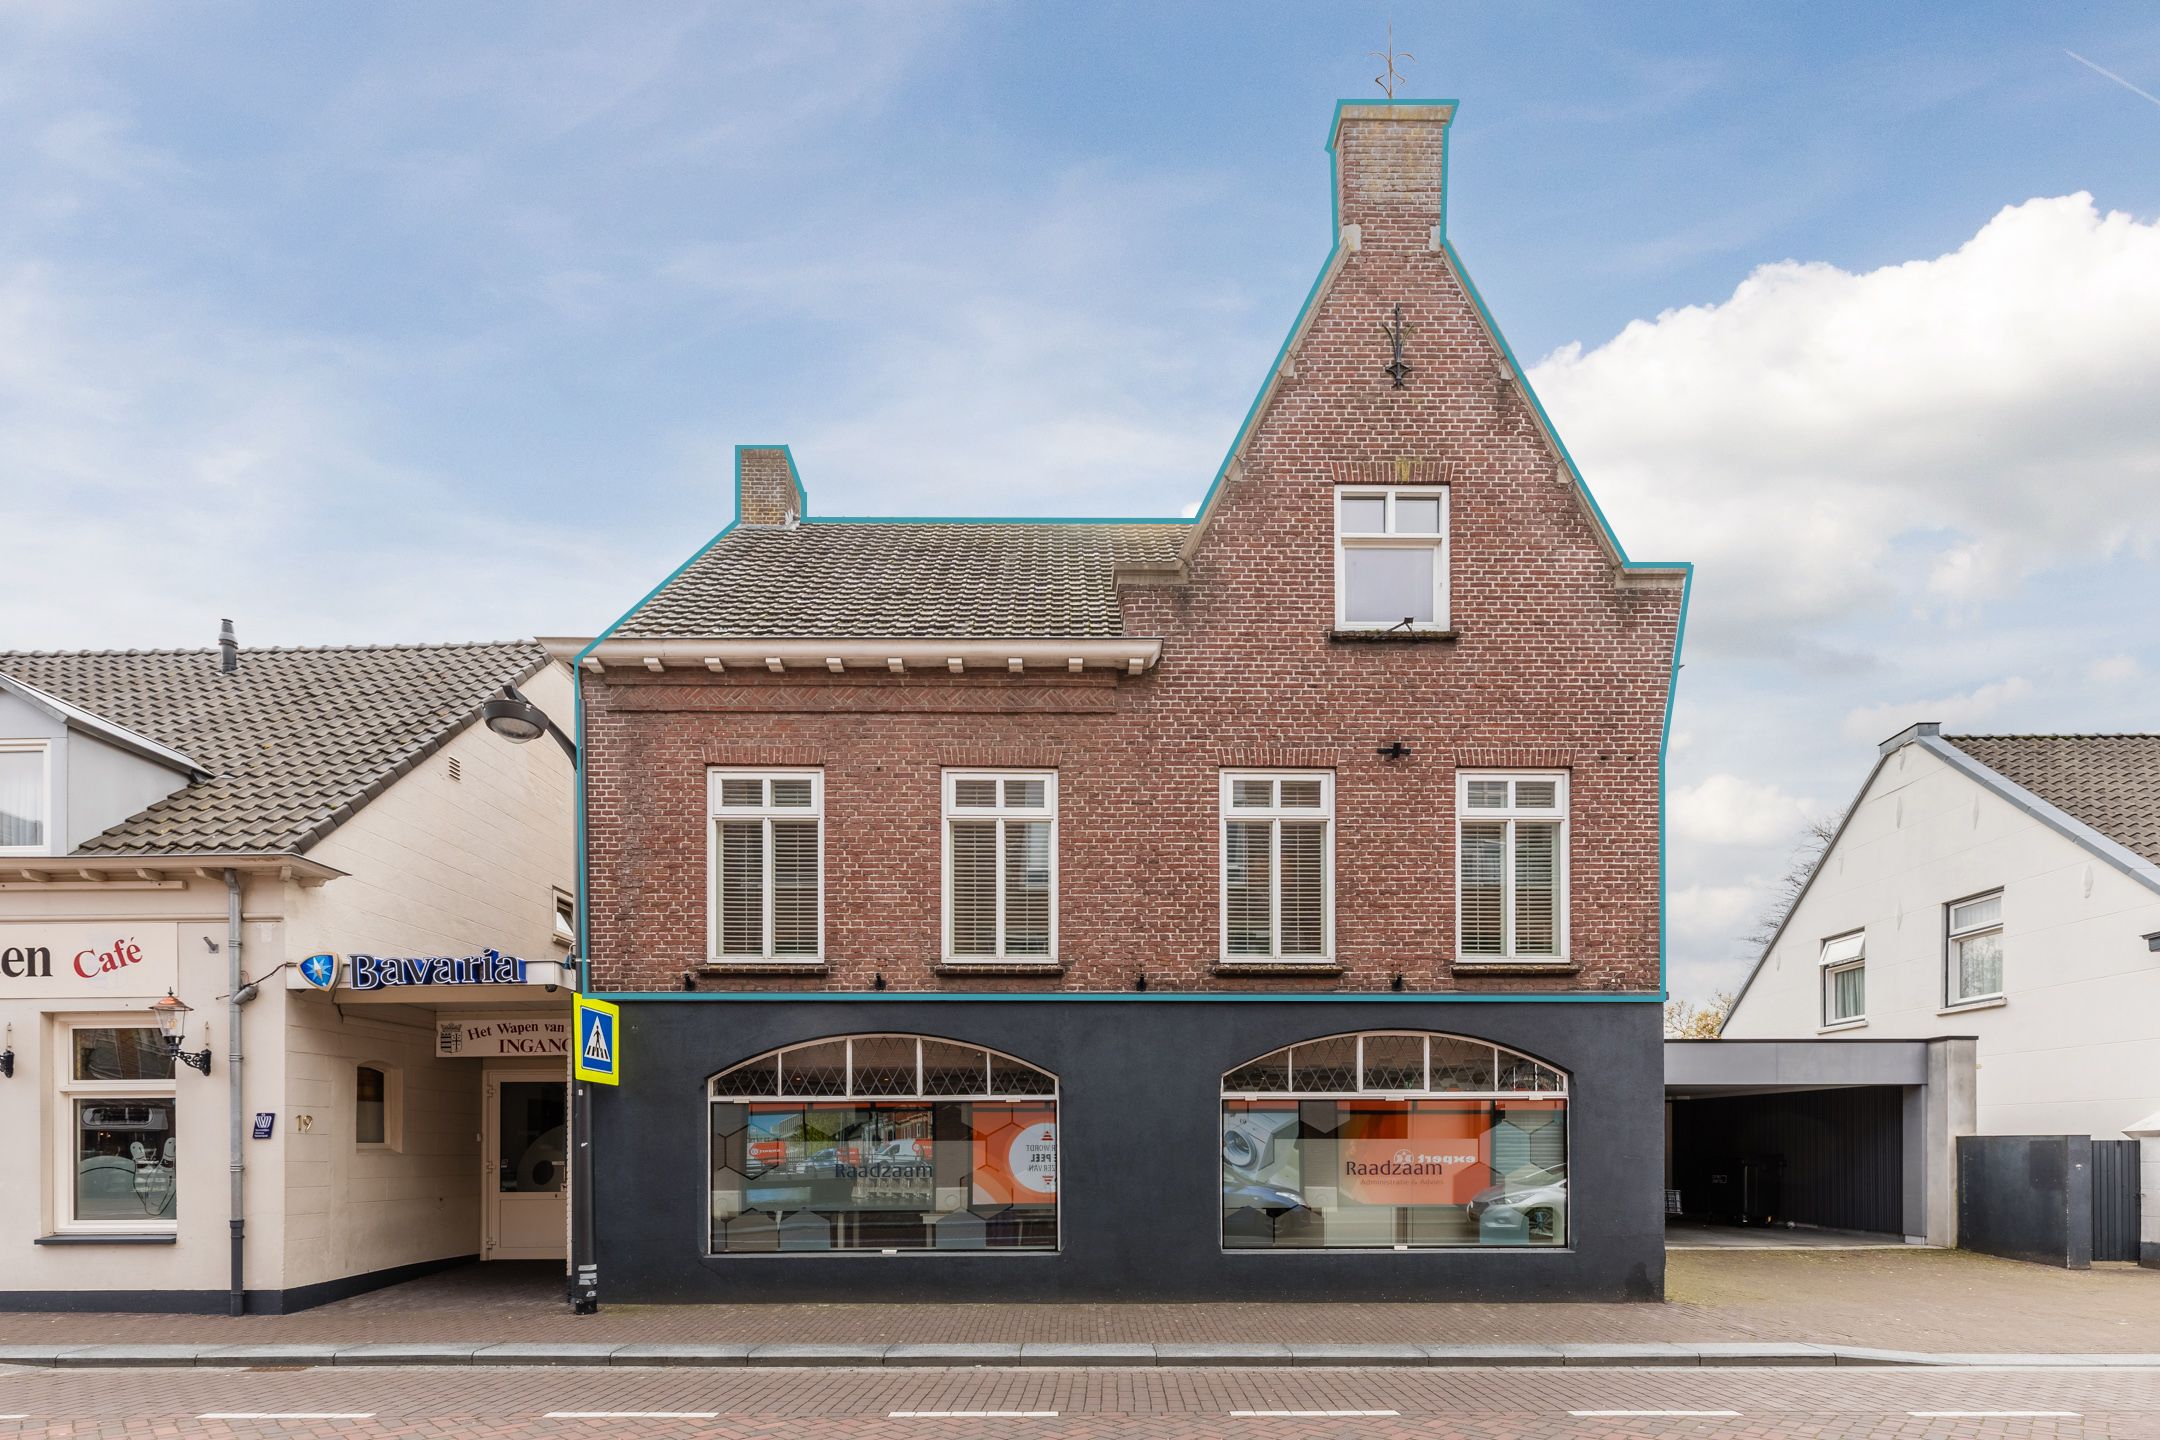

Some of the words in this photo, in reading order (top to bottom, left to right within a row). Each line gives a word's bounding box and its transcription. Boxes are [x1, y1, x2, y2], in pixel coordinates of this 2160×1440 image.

[0, 946, 54, 978] en
[73, 936, 143, 978] Café
[349, 948, 527, 990] Bavaria
[467, 1026, 492, 1040] Het
[497, 1022, 538, 1035] Wapen
[544, 1024, 565, 1033] van
[296, 1114, 313, 1133] 19
[835, 1163, 933, 1178] Raadzaam
[1346, 1160, 1442, 1175] Raadzaam
